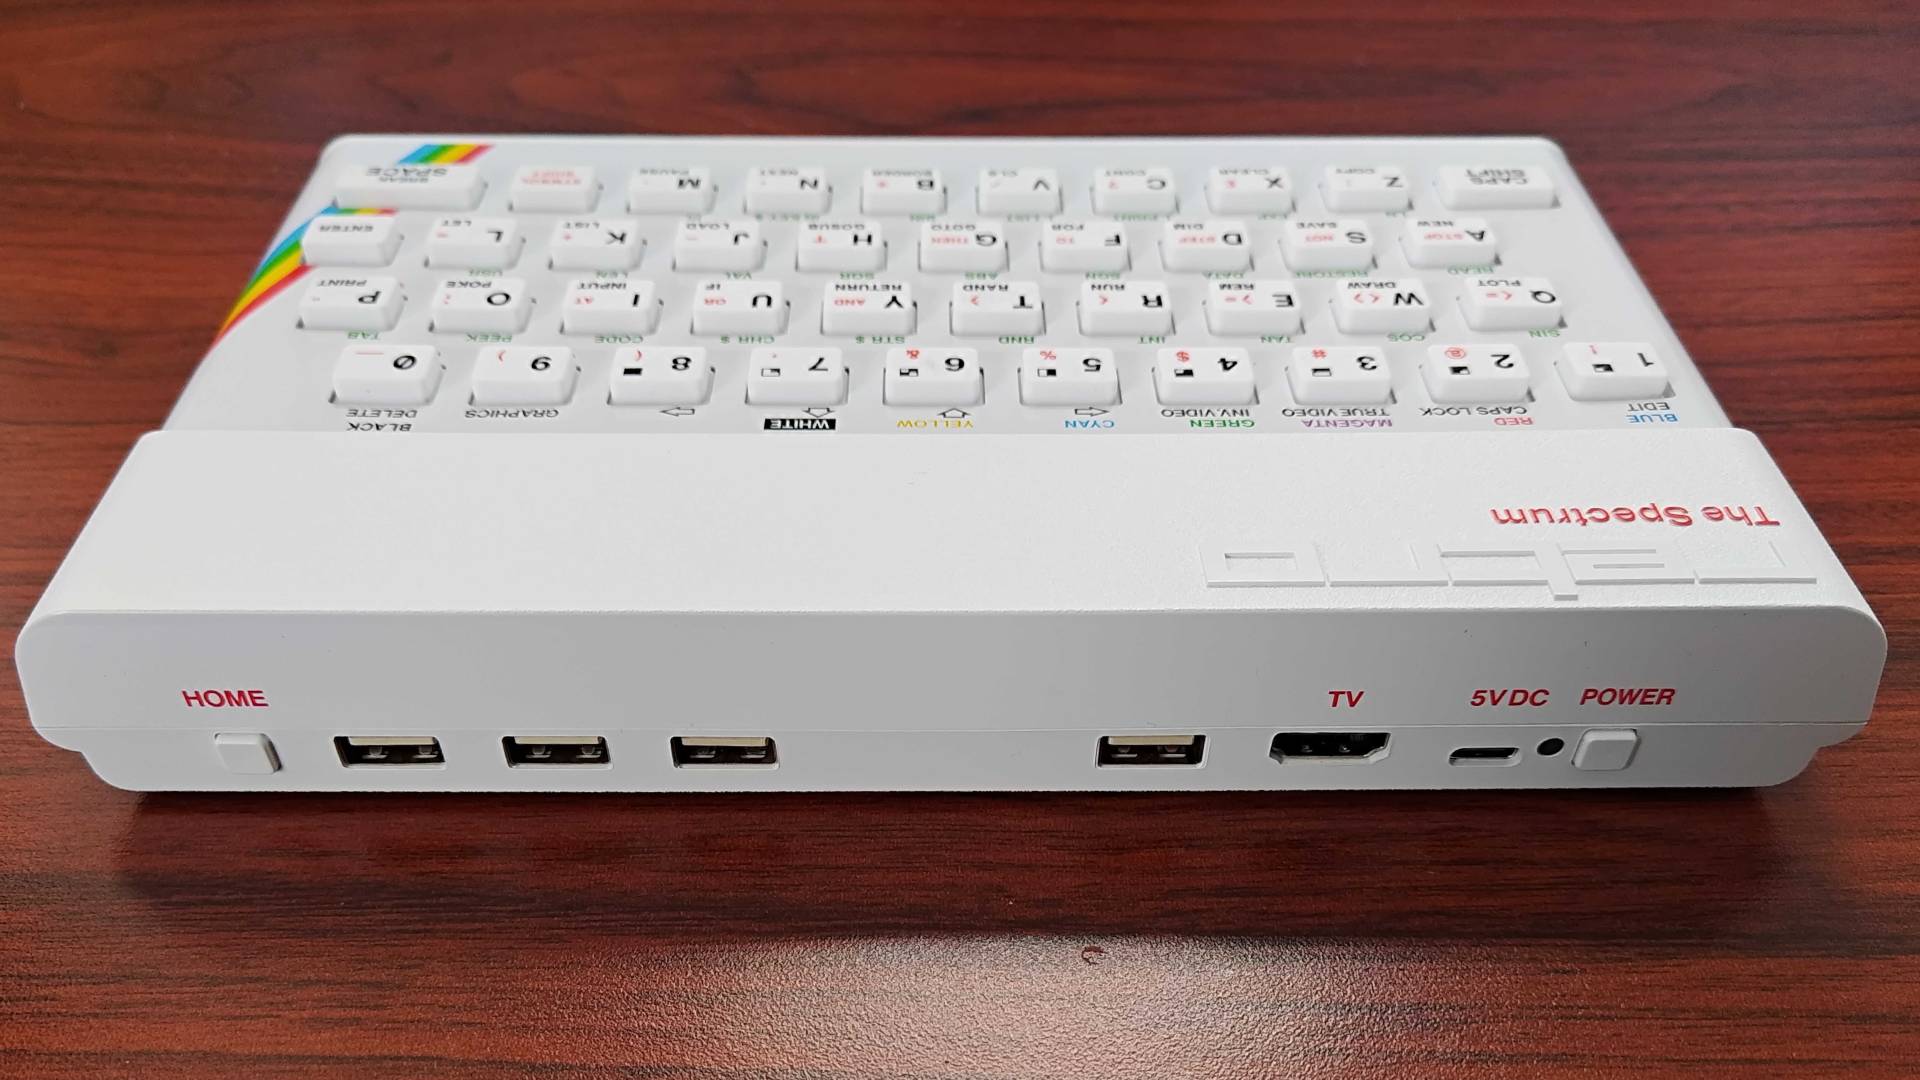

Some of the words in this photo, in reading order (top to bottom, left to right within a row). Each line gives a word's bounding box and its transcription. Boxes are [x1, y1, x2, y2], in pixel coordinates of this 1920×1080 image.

[365, 168, 448, 176] SPACE
[678, 179, 701, 188] M
[799, 179, 819, 190] N
[917, 179, 934, 190] B
[1032, 179, 1051, 191] V
[1147, 179, 1167, 190] C
[1265, 177, 1284, 189] X
[1383, 177, 1402, 187] Z
[486, 230, 503, 243] L
[605, 232, 627, 245] K
[733, 233, 749, 245] J
[852, 234, 873, 245] H
[975, 234, 998, 247] G
[1104, 234, 1121, 246] F
[1222, 233, 1242, 246] D
[1346, 232, 1366, 244] S
[1465, 230, 1485, 242] A
[318, 279, 367, 287] PRINT
[446, 281, 492, 289] POKE
[578, 282, 627, 290] INPUT
[962, 284, 1008, 292] RAND
[1091, 283, 1125, 291] RUN
[1219, 283, 1254, 291] REM
[1478, 279, 1521, 287] PLOT
[358, 291, 381, 304] P
[487, 293, 511, 305] O
[632, 294, 641, 307] I
[752, 294, 772, 308] U
[885, 295, 902, 308] Y
[1012, 296, 1033, 309] T
[1141, 295, 1163, 308] R
[1272, 294, 1294, 308] E
[1393, 292, 1424, 306] W
[1530, 290, 1557, 304] Q
[531, 357, 552, 370] 9
[672, 357, 692, 371] 8
[808, 358, 828, 371] 7
[945, 358, 964, 371] 6
[1082, 358, 1102, 372] 5
[1218, 358, 1238, 371] 4
[1357, 356, 1378, 371] 3
[1491, 354, 1514, 369] 2
[1637, 352, 1654, 367] 1
[1418, 407, 1471, 416] LOCK
[1476, 407, 1528, 416] CAPS
[1628, 402, 1670, 412] EDIT
[346, 409, 417, 418] DELETE
[465, 410, 559, 418] GRAPHICS
[1626, 413, 1678, 424] BLUE
[346, 423, 412, 431] BLACK
[771, 419, 829, 429] WHITE
[897, 420, 973, 428] YELLOW
[1064, 420, 1114, 428] CYAN
[1190, 419, 1255, 428] GREEN
[1301, 419, 1392, 428] MAGENTA
[1494, 418, 1533, 426] RED
[1490, 506, 1691, 529] Spectrum
[1702, 505, 1779, 527] The
[182, 688, 268, 708] HOME
[1328, 690, 1365, 708] TV
[1580, 688, 1676, 706] POWER
